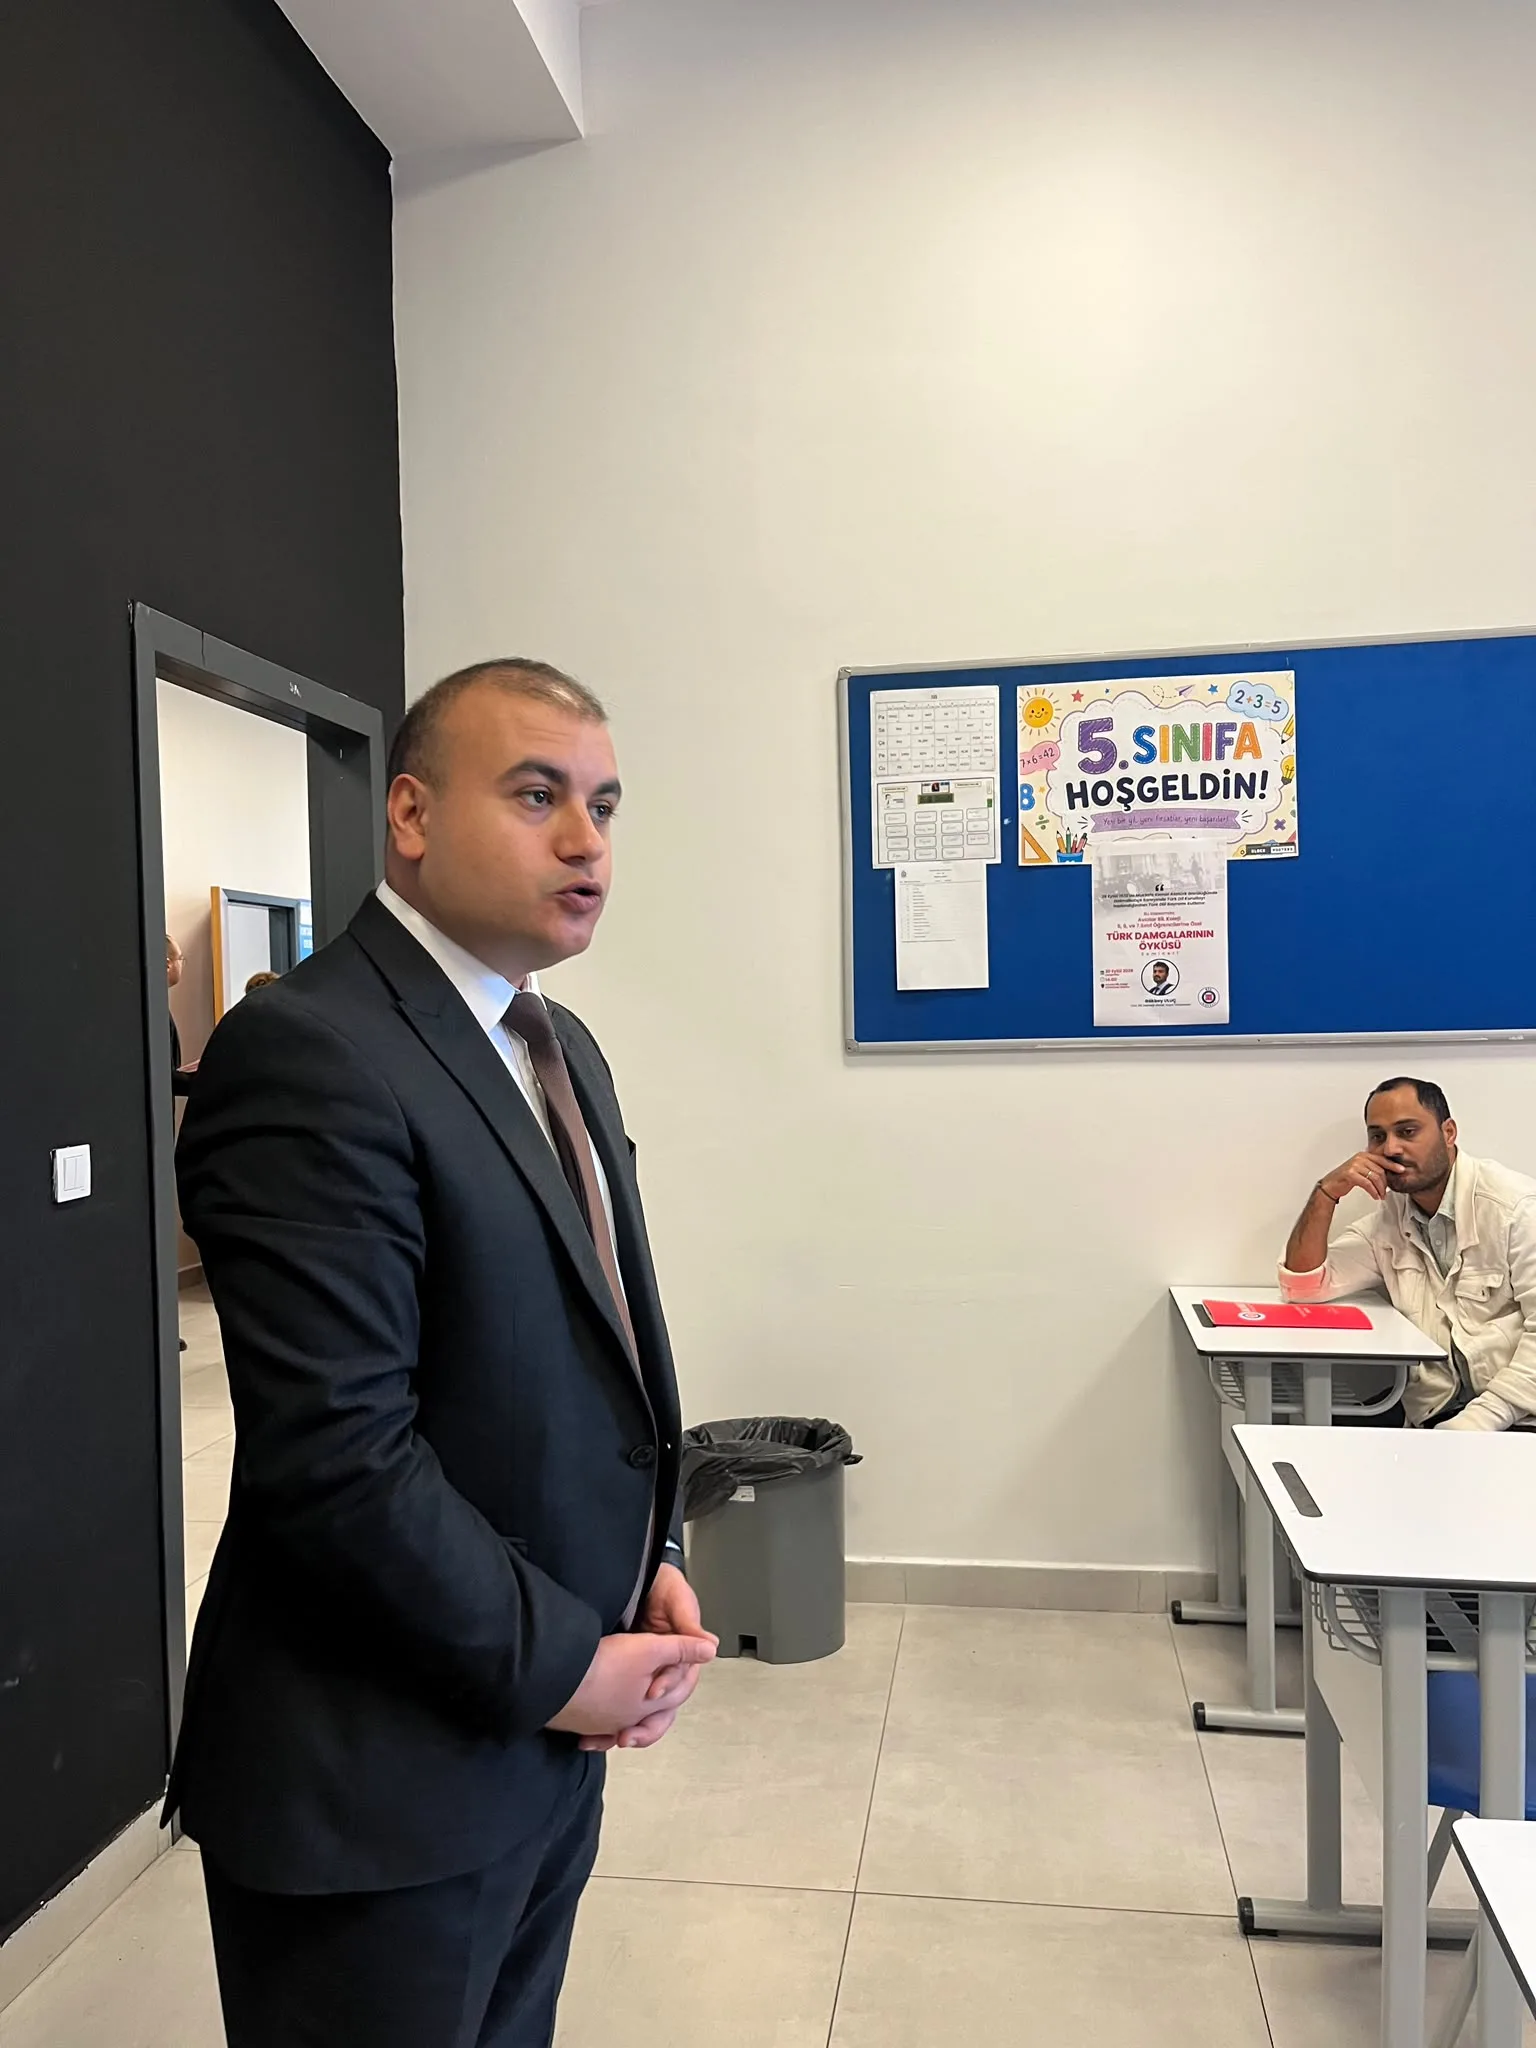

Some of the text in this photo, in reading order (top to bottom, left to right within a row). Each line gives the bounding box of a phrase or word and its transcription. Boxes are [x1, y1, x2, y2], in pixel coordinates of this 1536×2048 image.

[1077, 717, 1262, 775] 5. SINIFA
[1020, 783, 1035, 811] B
[1066, 768, 1269, 811] HOŞGELDİN!
[1106, 930, 1214, 941] TÜRK DAMGALARININ
[1139, 940, 1181, 950] ÖYKÜSÜ
